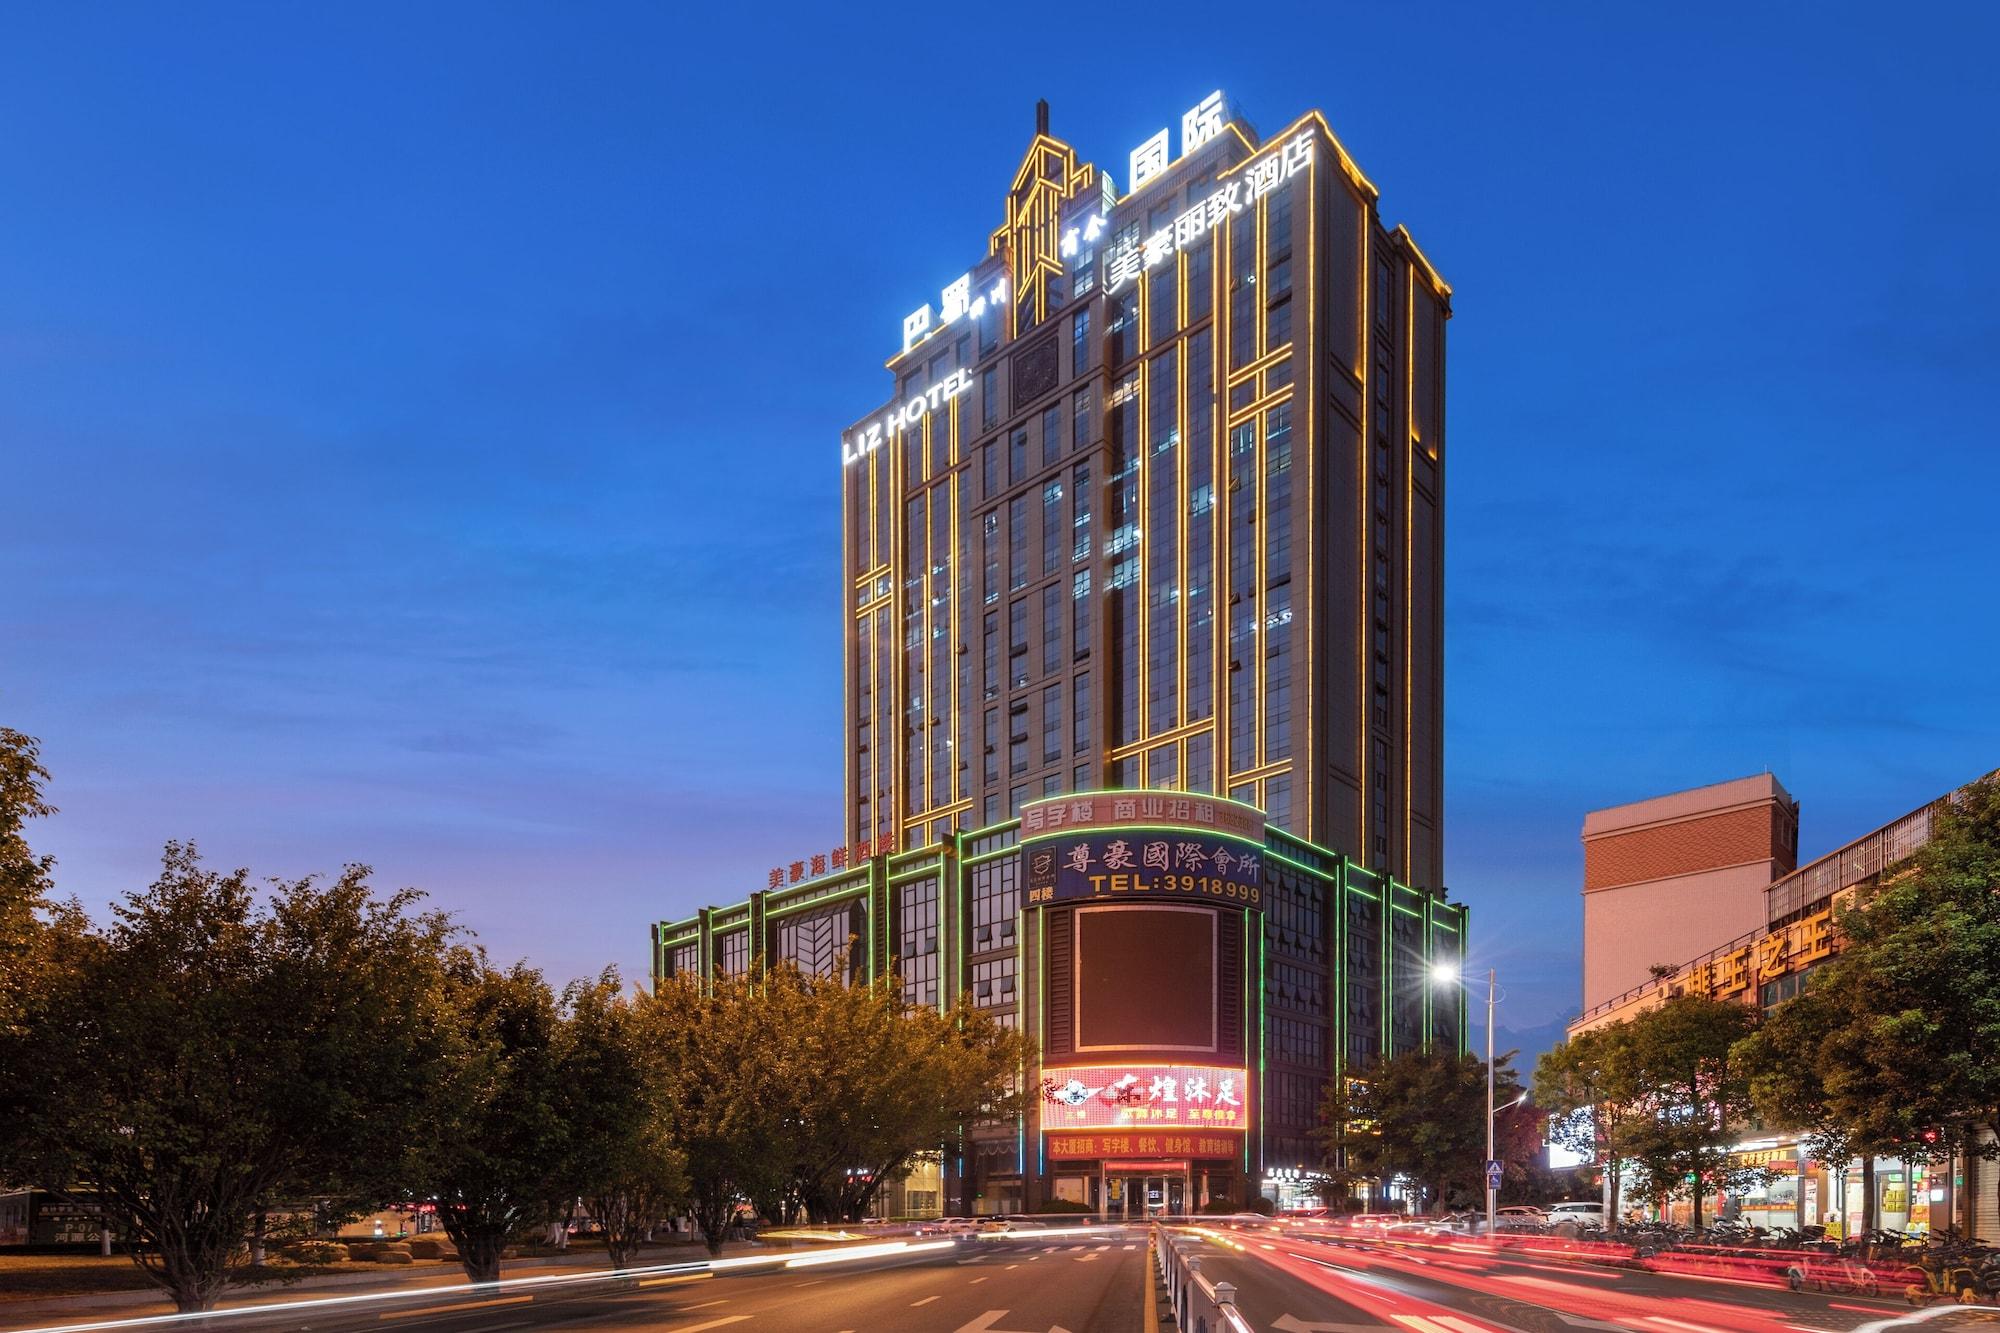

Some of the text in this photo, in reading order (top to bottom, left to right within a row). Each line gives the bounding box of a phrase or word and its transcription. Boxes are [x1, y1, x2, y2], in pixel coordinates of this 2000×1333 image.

[1130, 89, 1223, 195] 国际
[1108, 129, 1314, 294] 美豪丽致酒店
[843, 367, 973, 464] LIZ HOTEL
[1026, 801, 1094, 830] 写字楼
[1114, 798, 1215, 824] 商业招租
[769, 831, 896, 889] 美豪海鲜酒楼
[1063, 839, 1261, 884] 尊豪國際會所
[1088, 873, 1260, 903] TEL:3918999
